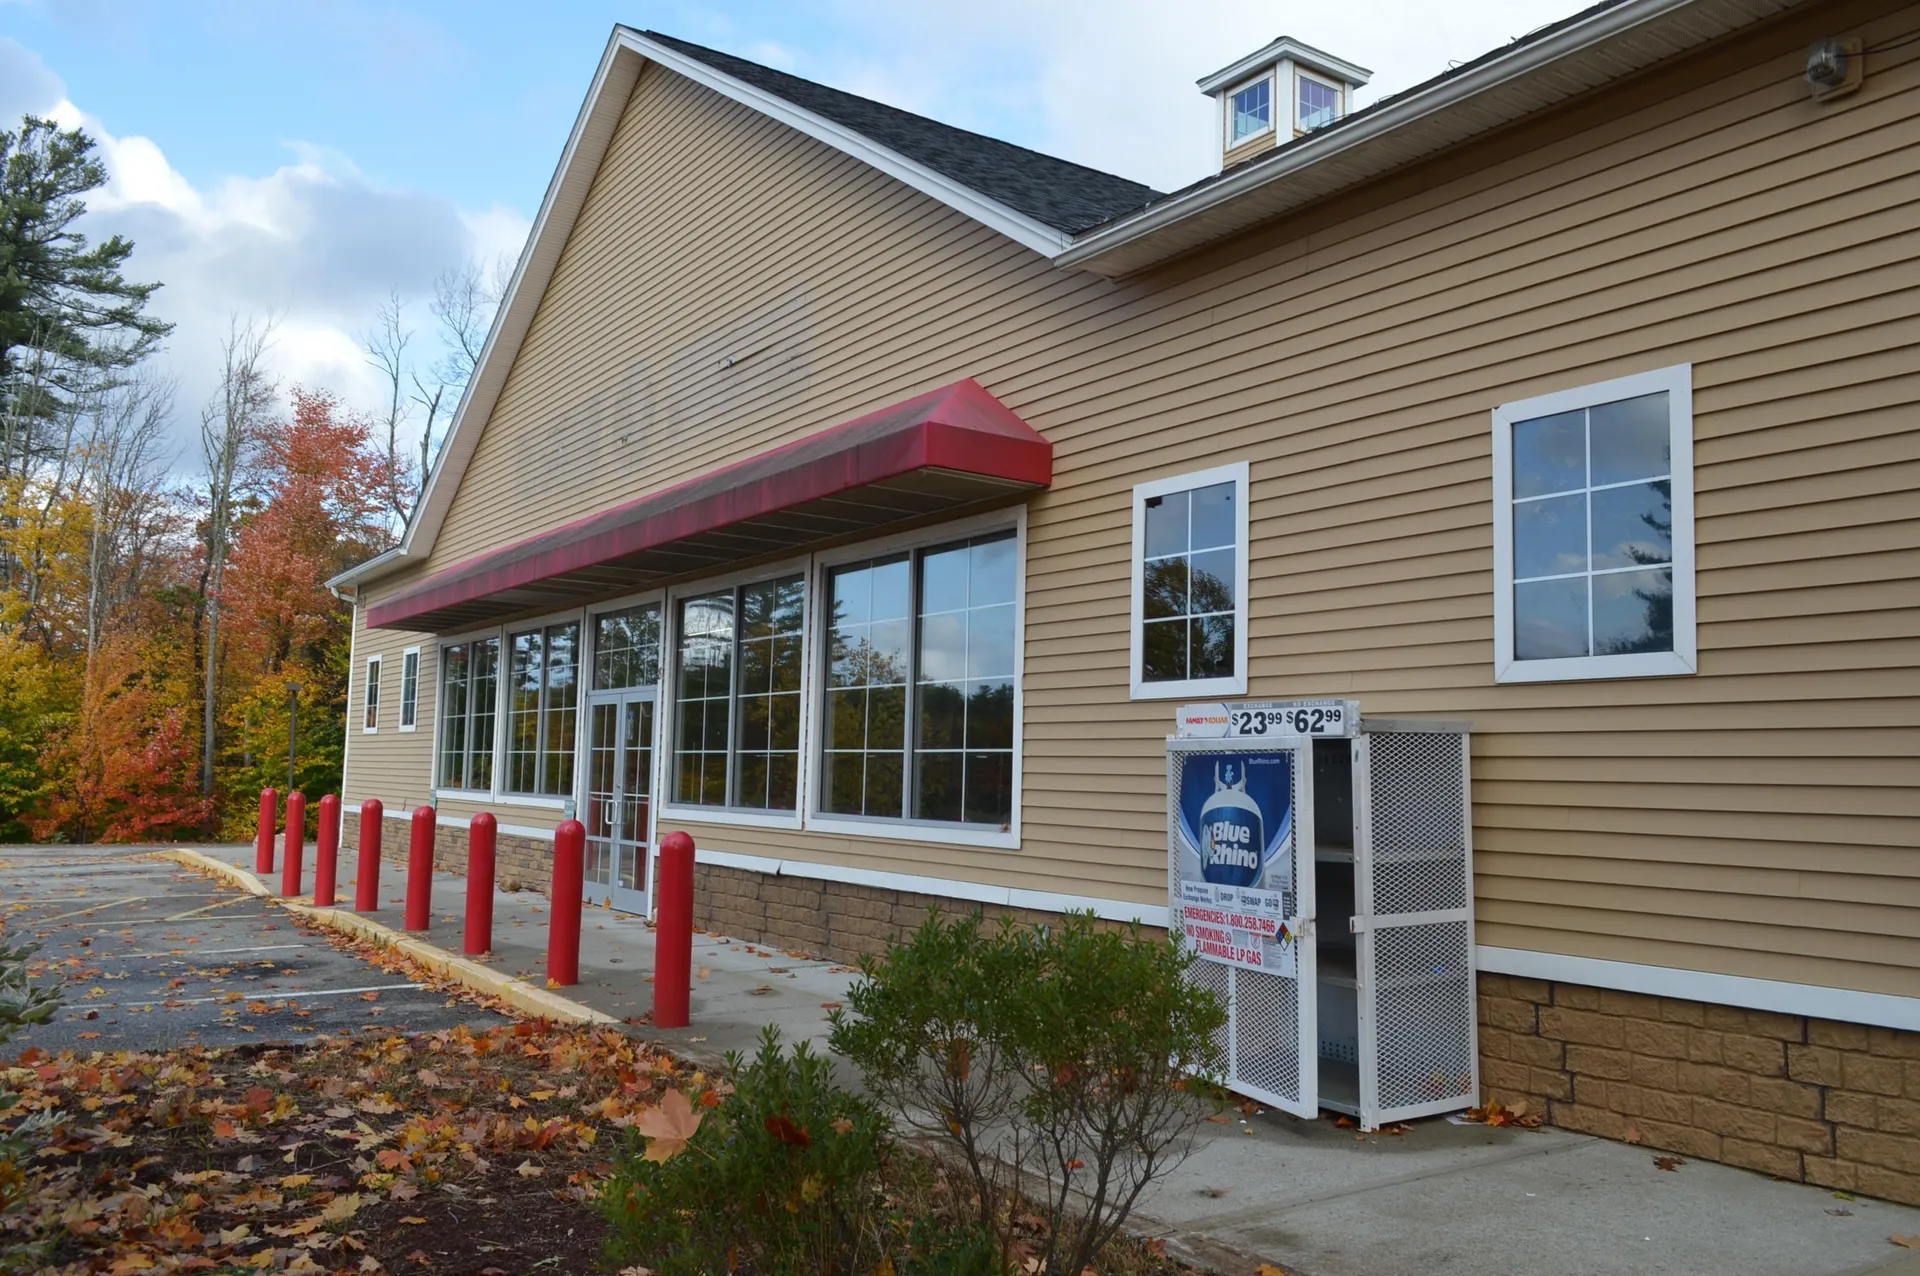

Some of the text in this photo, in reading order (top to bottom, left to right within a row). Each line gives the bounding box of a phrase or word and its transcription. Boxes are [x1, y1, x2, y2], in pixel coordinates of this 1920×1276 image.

[1212, 820, 1250, 844] Blue
[1209, 843, 1258, 869] Rhino
[1220, 892, 1234, 902] DROP
[1246, 896, 1262, 907] SWAP
[1186, 924, 1195, 937] NO
[1195, 926, 1225, 944] SMOKING
[1195, 939, 1235, 961] FLAMMABLE
[1236, 948, 1245, 962] LP
[1246, 950, 1262, 966] GAS
